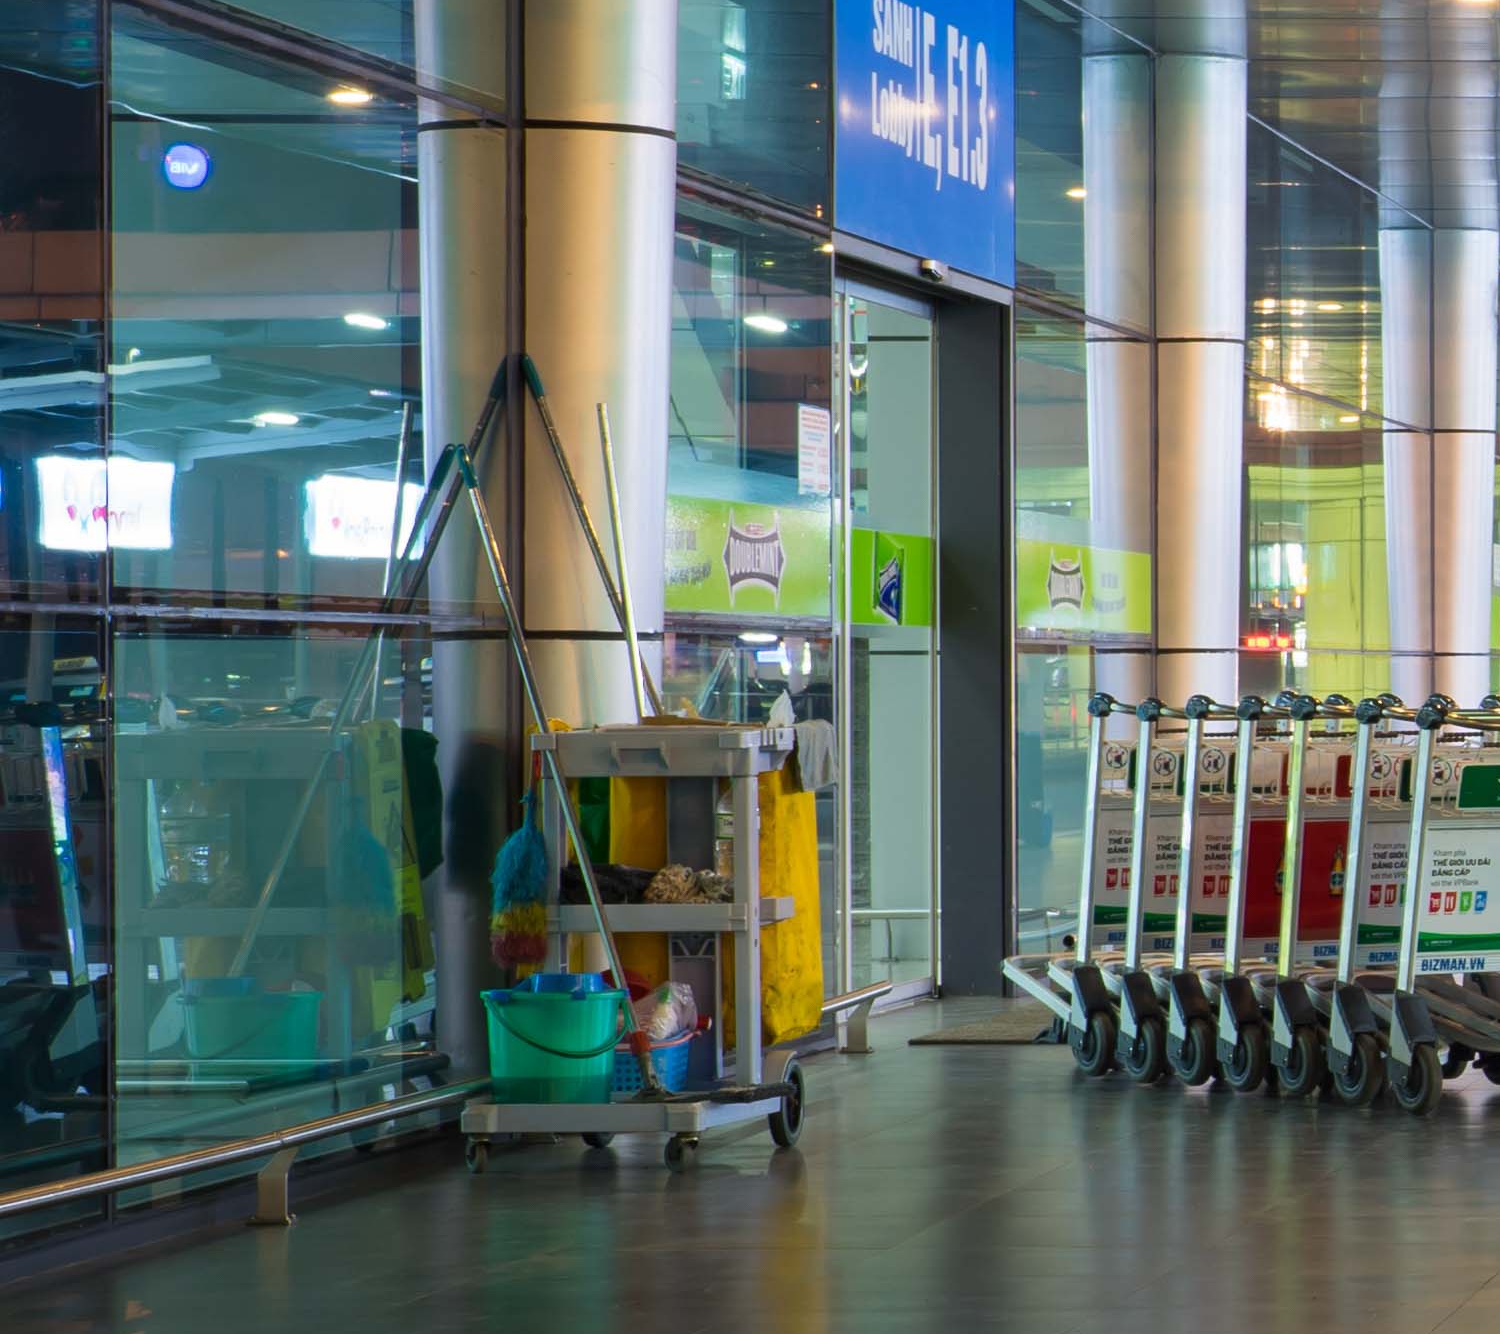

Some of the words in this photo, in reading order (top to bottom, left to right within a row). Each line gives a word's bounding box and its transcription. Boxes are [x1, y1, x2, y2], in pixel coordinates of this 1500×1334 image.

[870, 71, 914, 158] Lobby
[946, 24, 989, 192] E1.3
[1421, 957, 1485, 972] BIZMAN.VN
